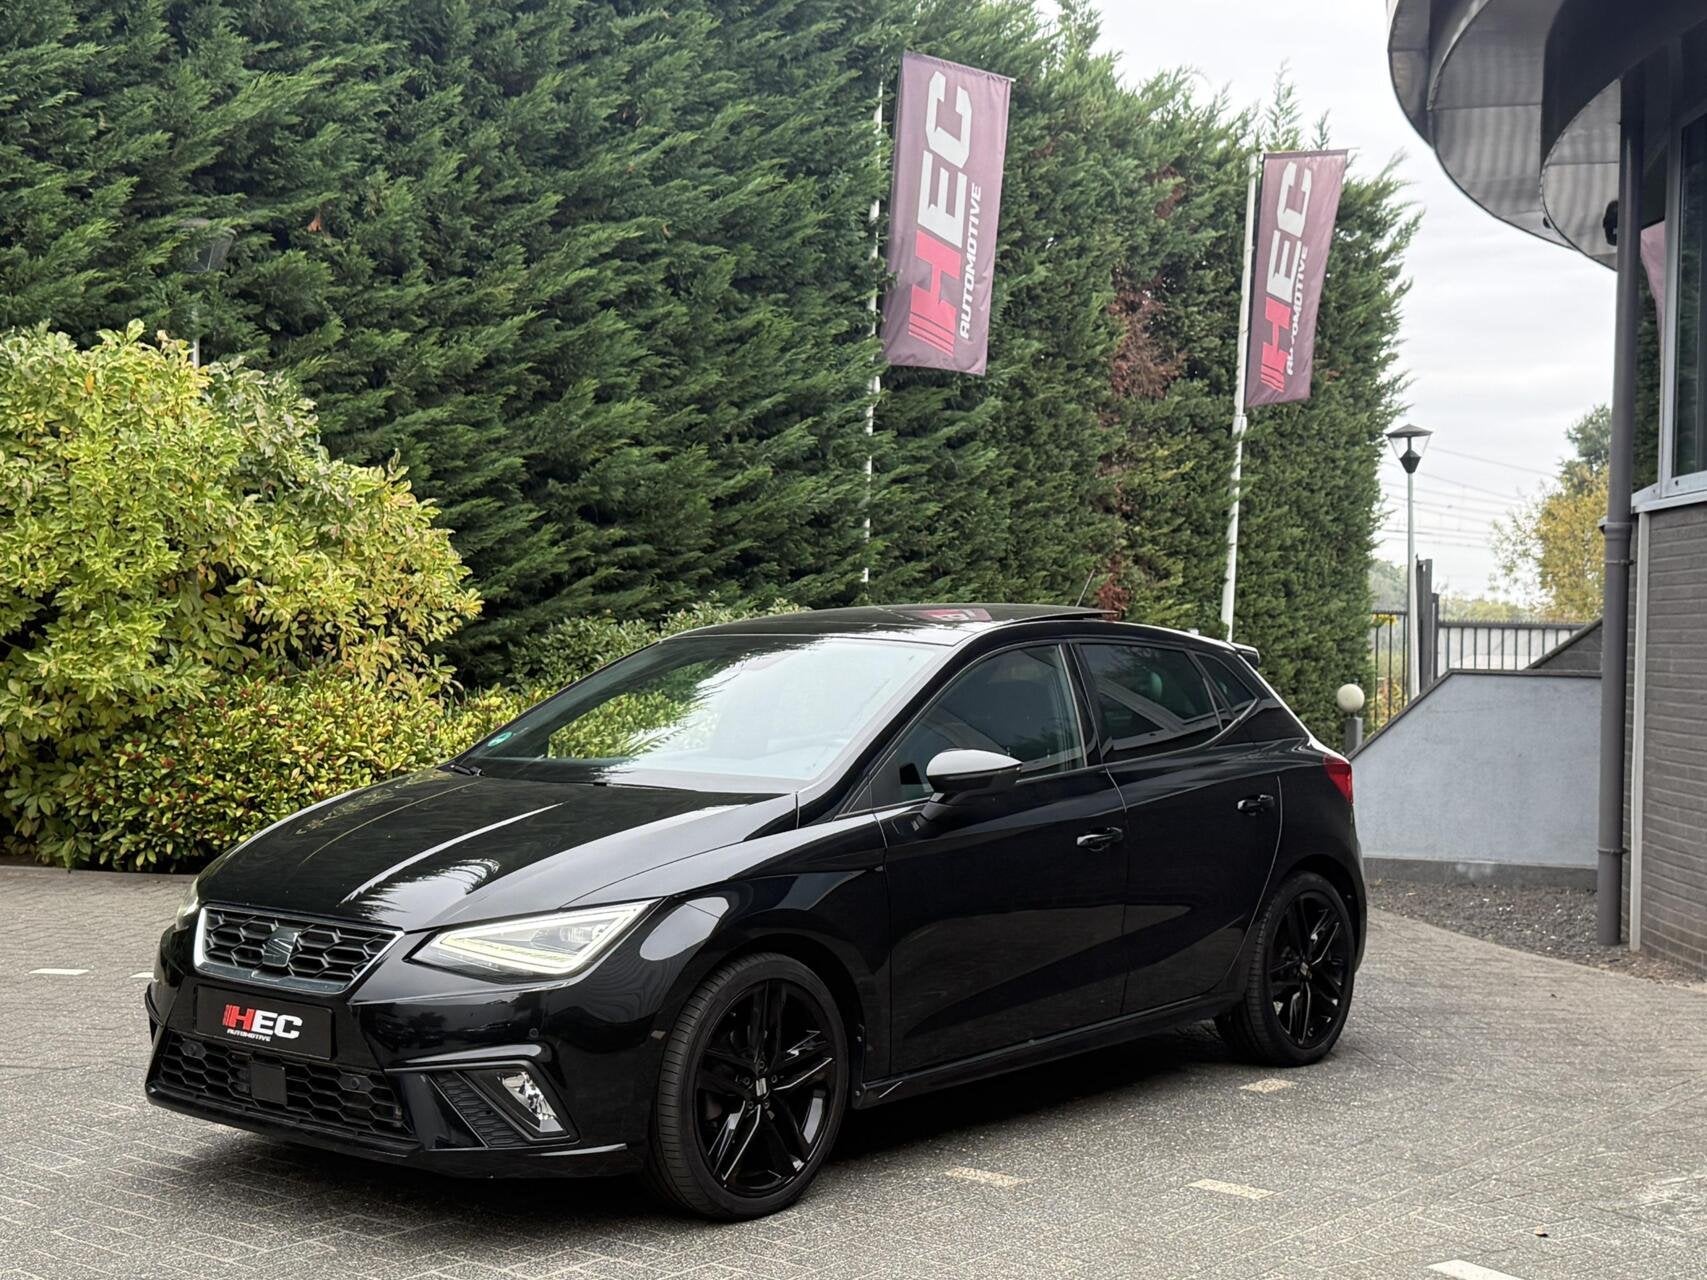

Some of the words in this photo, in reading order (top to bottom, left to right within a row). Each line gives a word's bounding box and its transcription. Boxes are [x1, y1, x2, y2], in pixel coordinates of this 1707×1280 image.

[909, 70, 973, 358] HEC
[959, 182, 982, 340] AUTOMOTIVE
[1260, 161, 1312, 393] HEC
[222, 1004, 303, 1040] HEC
[226, 1028, 272, 1042] AUTOMOTIVE
